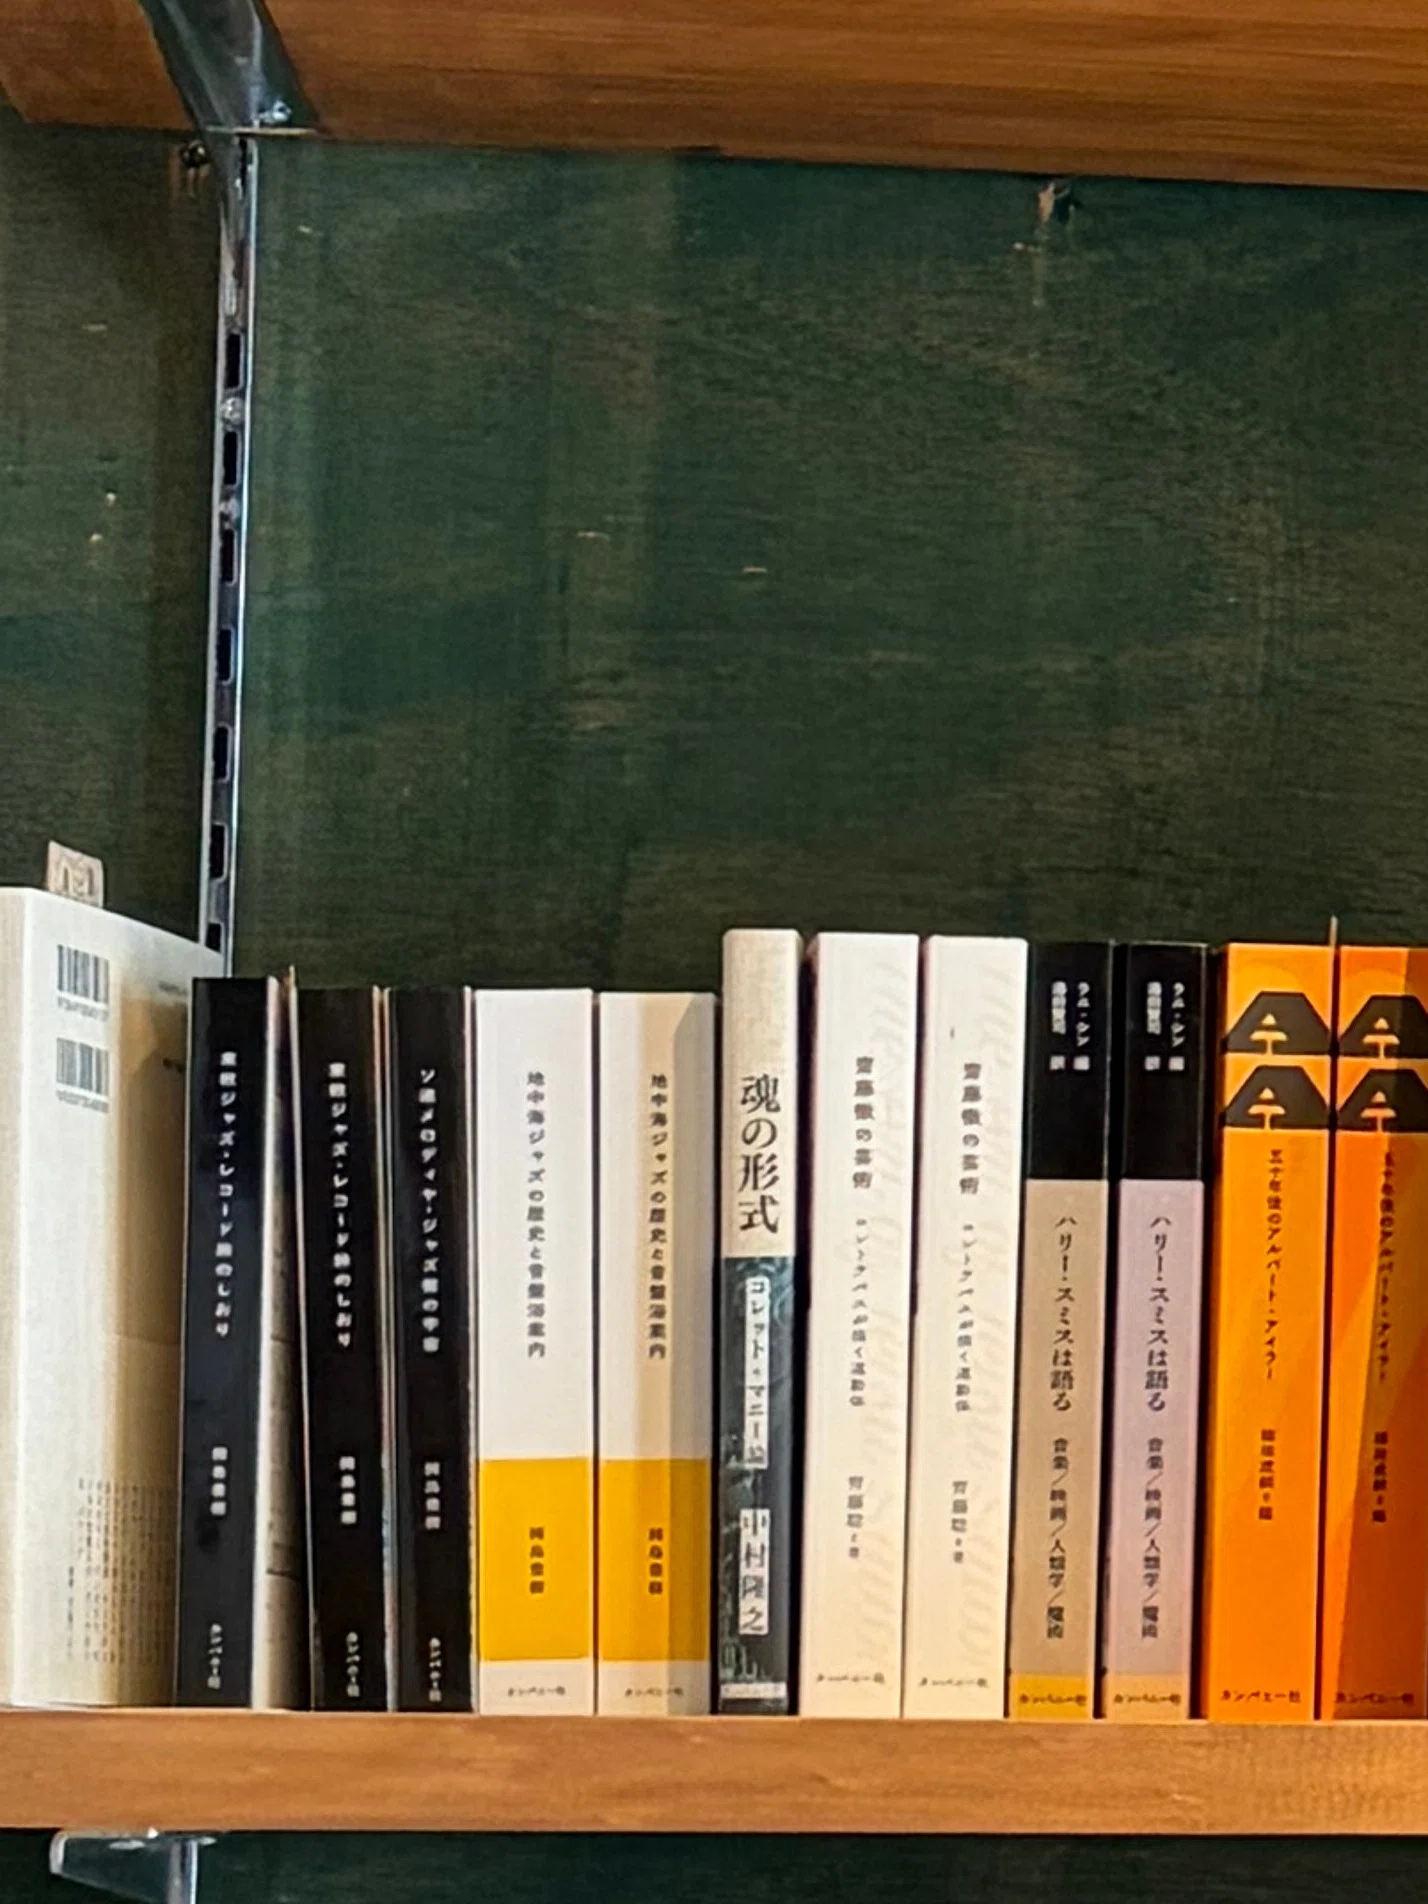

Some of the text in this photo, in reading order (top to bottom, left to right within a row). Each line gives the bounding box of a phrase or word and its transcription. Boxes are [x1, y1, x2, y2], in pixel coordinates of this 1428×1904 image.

[737, 1072, 782, 1236] 魂の形式
[1049, 1215, 1079, 1413] ハリー・スミスは語る
[1144, 1215, 1173, 1413] ハリー・スミスは語る
[741, 1510, 768, 1633] 中村隆之
